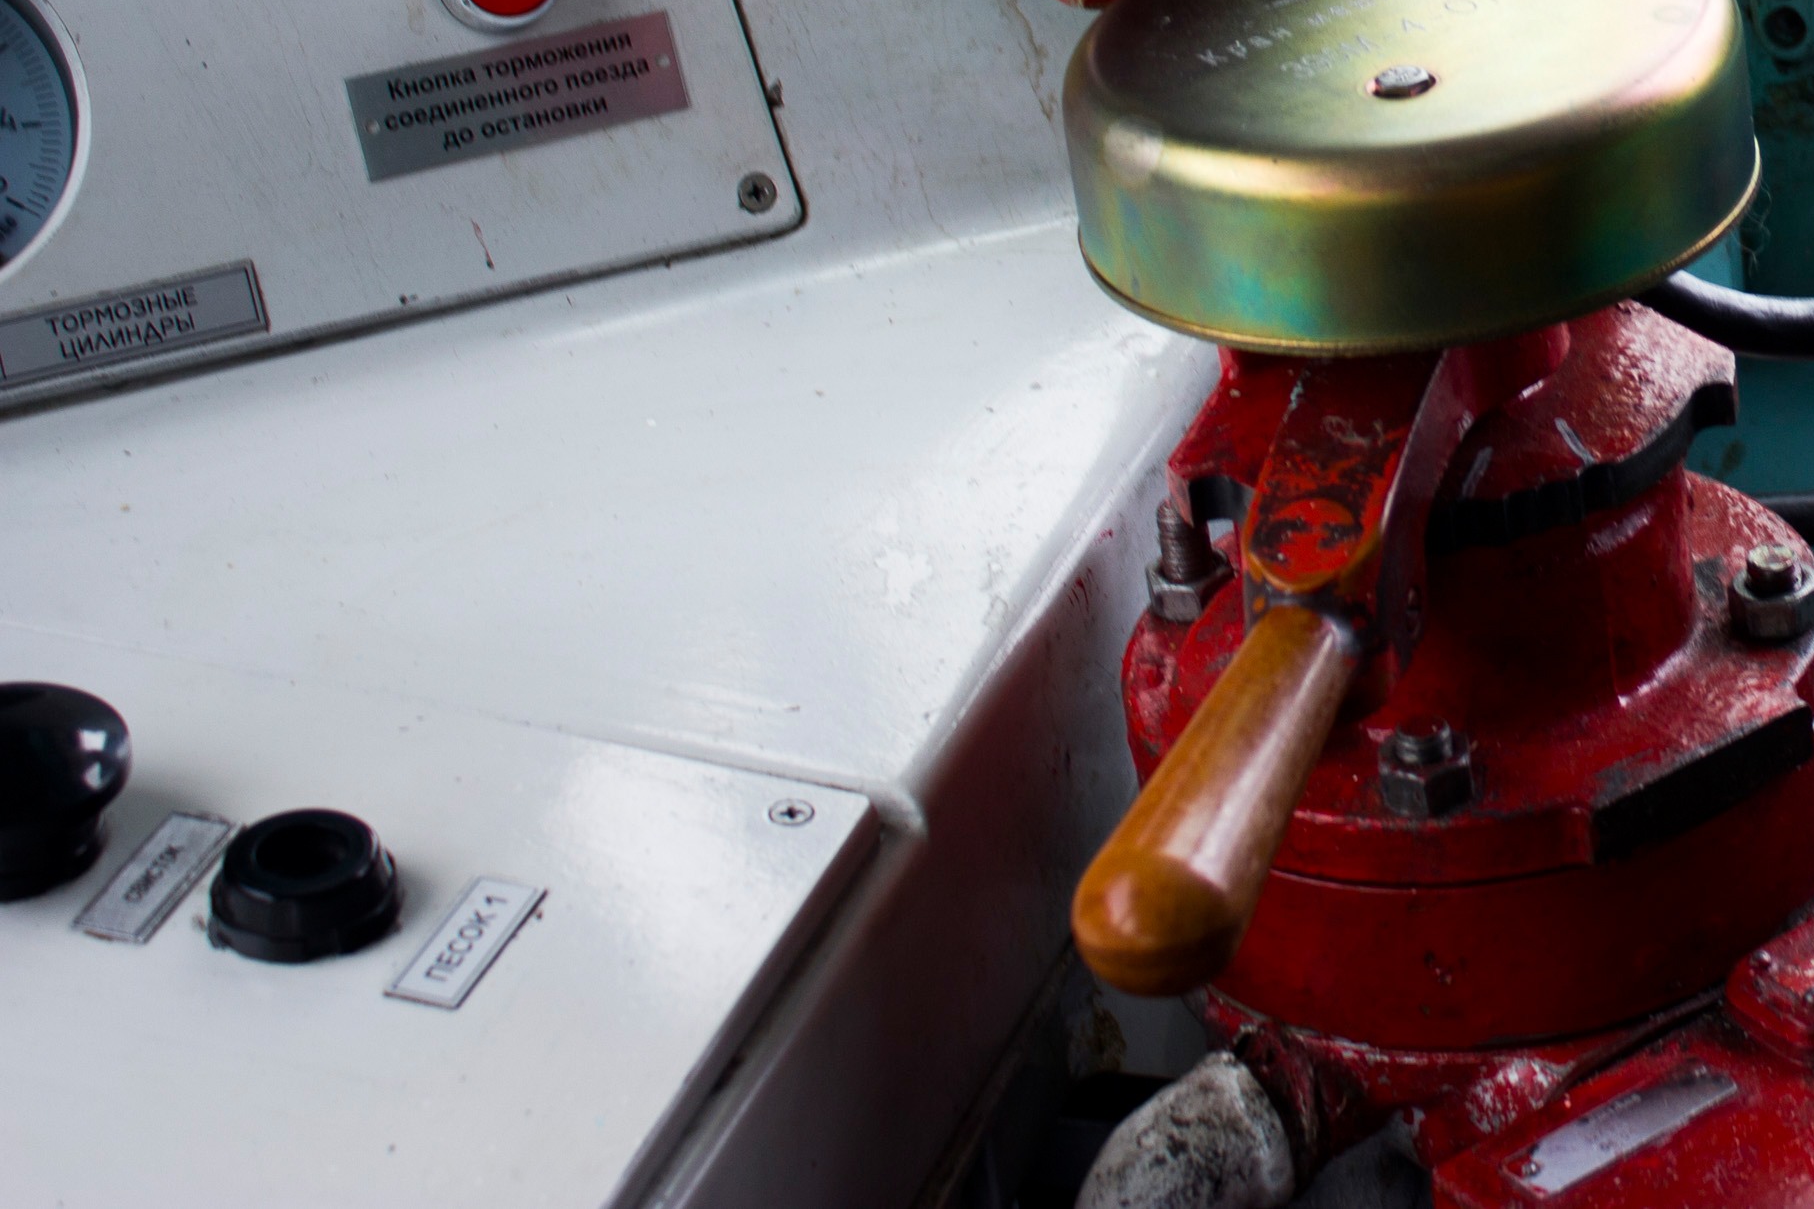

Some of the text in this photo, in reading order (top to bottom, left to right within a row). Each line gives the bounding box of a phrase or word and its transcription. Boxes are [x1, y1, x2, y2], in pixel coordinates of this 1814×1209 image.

[384, 57, 650, 132] соединенного поезда
[386, 32, 632, 101] Кнопка торможения
[443, 95, 608, 151] до остановки
[45, 286, 198, 336] ТОРМОЗНЫЕ
[59, 312, 195, 362] ЦИЛИНДРЫ
[424, 907, 492, 983] ПЕСОК
